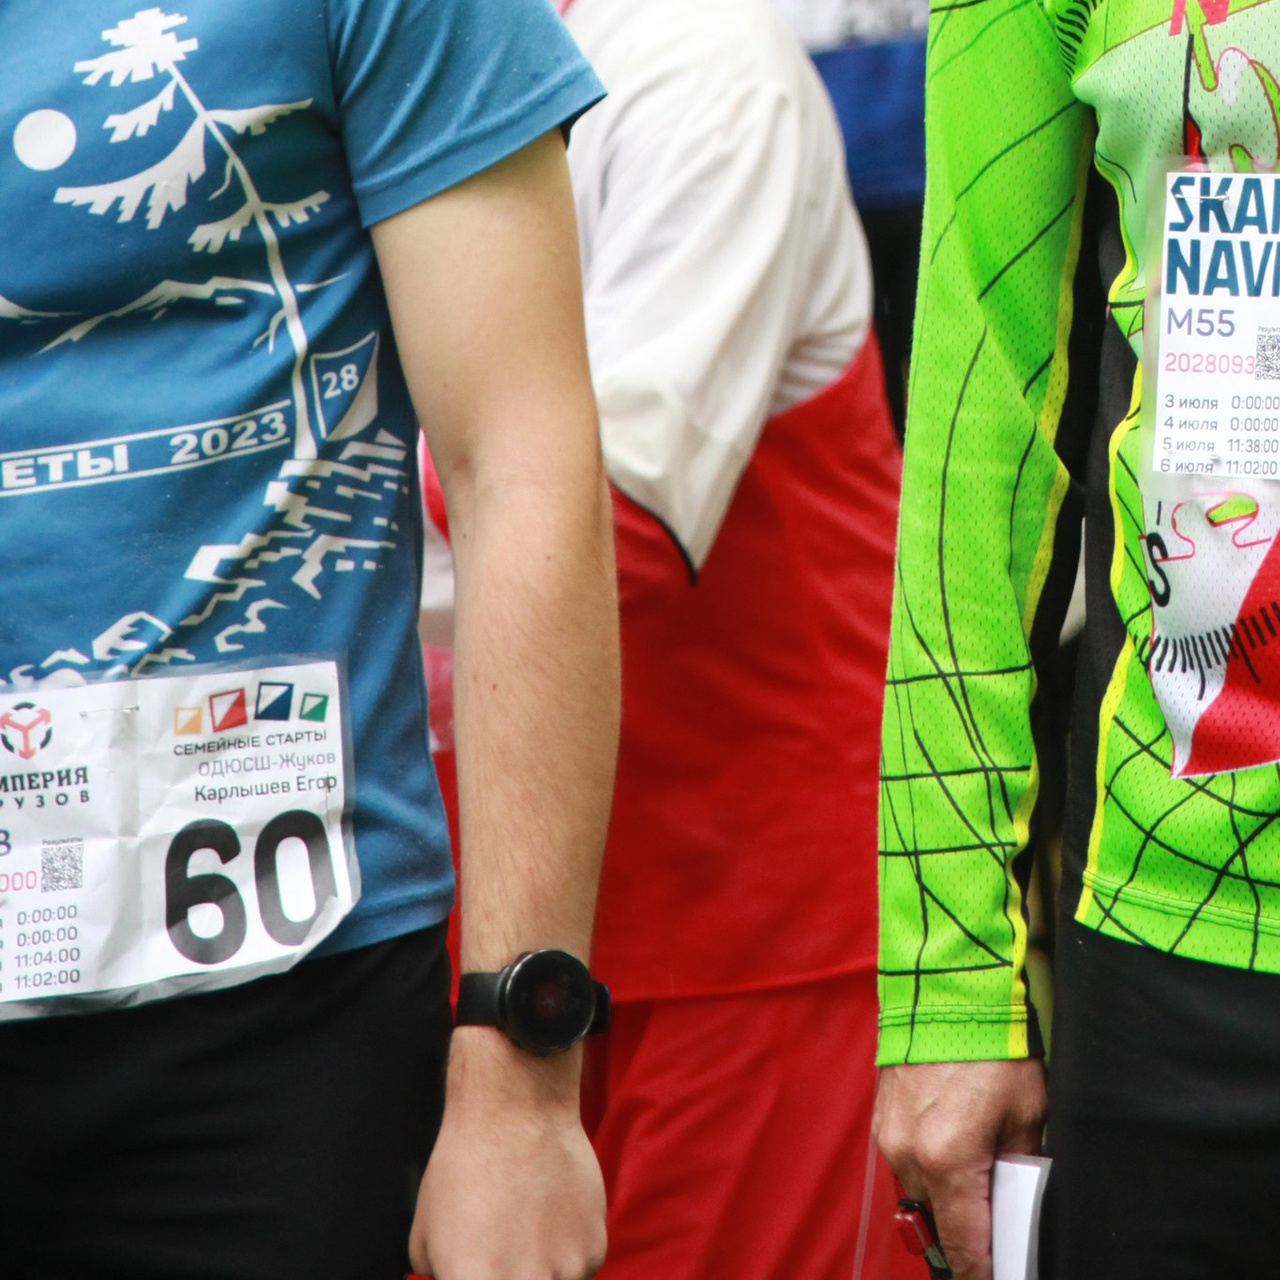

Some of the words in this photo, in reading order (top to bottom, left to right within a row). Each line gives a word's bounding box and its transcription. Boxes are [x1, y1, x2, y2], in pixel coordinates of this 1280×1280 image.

[1164, 352, 1256, 375] 2028093
[322, 363, 359, 400] 28
[1164, 394, 1175, 409] 3
[1178, 397, 1219, 410] июля
[1231, 395, 1280, 411] 0:00:00
[1163, 415, 1174, 430] 4
[1178, 419, 1219, 431] июля
[1230, 417, 1279, 432] 0:00:00
[1, 444, 129, 489] ЕТЫ
[169, 411, 287, 465] 2023
[1162, 437, 1172, 451] 5
[1176, 440, 1215, 453] июля
[1227, 438, 1280, 453] 11:38:00
[1160, 458, 1171, 473] 6
[1175, 462, 1214, 474] июля
[1225, 460, 1278, 475] 11:02:00
[1145, 532, 1171, 608] S
[173, 736, 261, 757] СЕМЕЙНЫЕ
[266, 729, 327, 747] СТАРТЫ
[198, 752, 336, 778] ОДЮСШ-Жуков
[194, 779, 291, 804] Карлышев
[296, 773, 338, 793] Егор
[164, 809, 339, 965] 60
[17, 905, 78, 926] 0:00:00
[17, 926, 78, 947] 0:00:00
[14, 947, 81, 968] 11:04:00
[14, 969, 81, 990] 11:02:00
